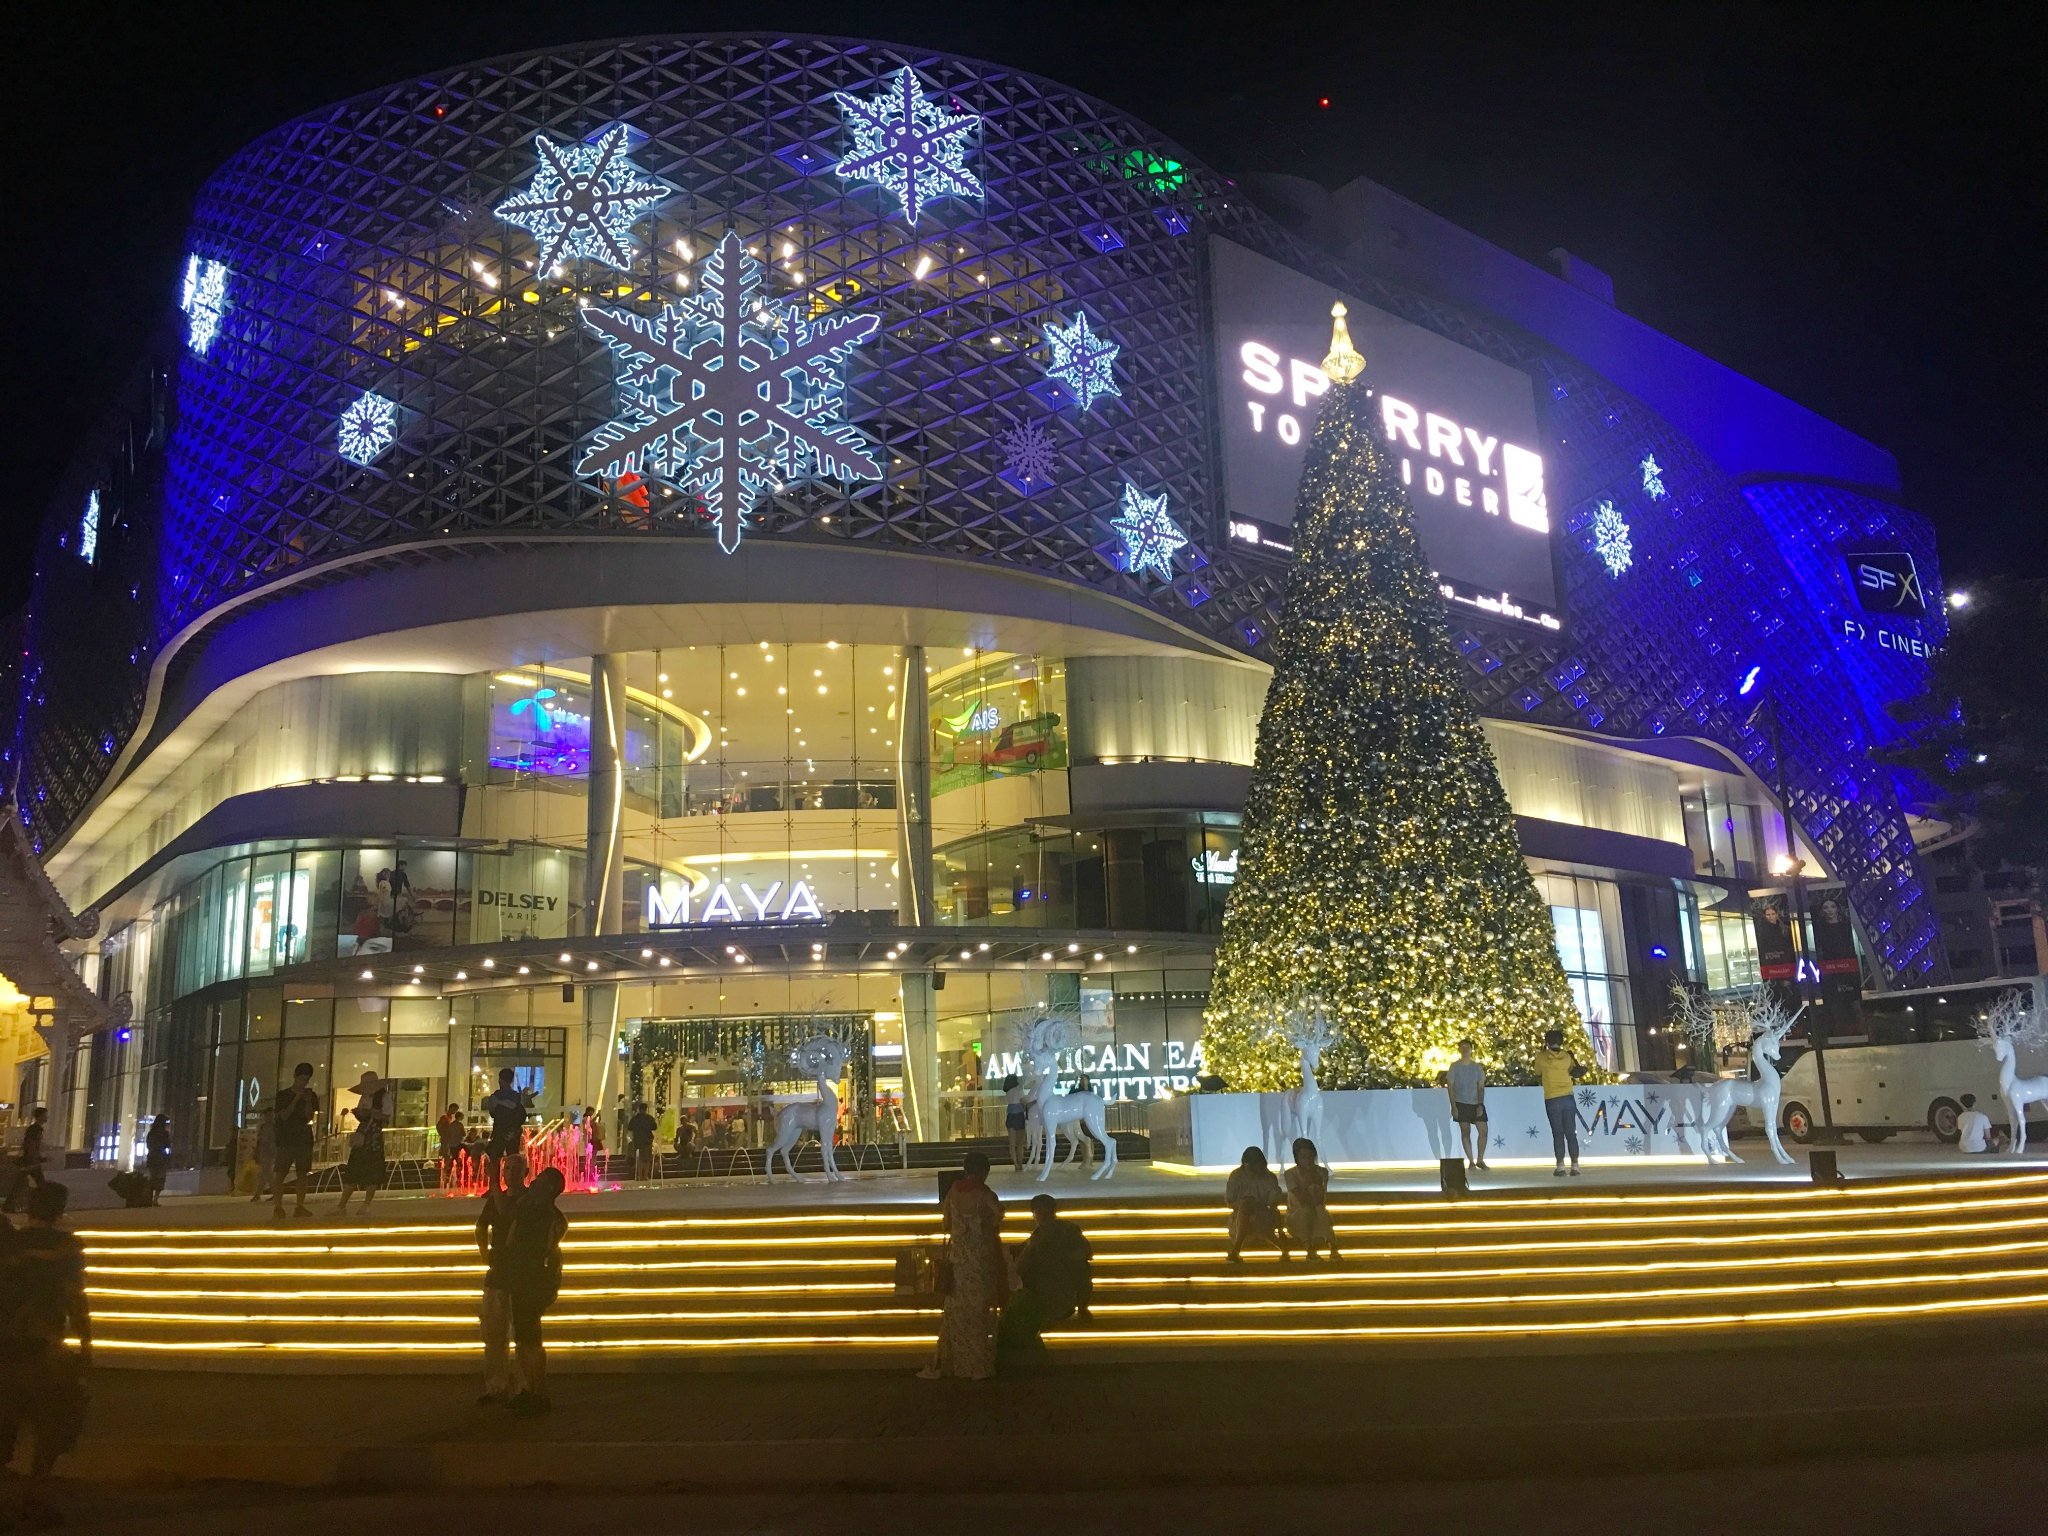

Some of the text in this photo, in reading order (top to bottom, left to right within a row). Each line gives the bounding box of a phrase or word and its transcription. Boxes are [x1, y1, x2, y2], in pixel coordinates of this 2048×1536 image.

[1241, 341, 1497, 476] SPRRY
[1859, 563, 1917, 608] SFX
[971, 707, 999, 731] AIS
[479, 890, 558, 911] DELSEY
[648, 880, 823, 924] MAYA
[986, 1042, 1151, 1080] AMICAN
